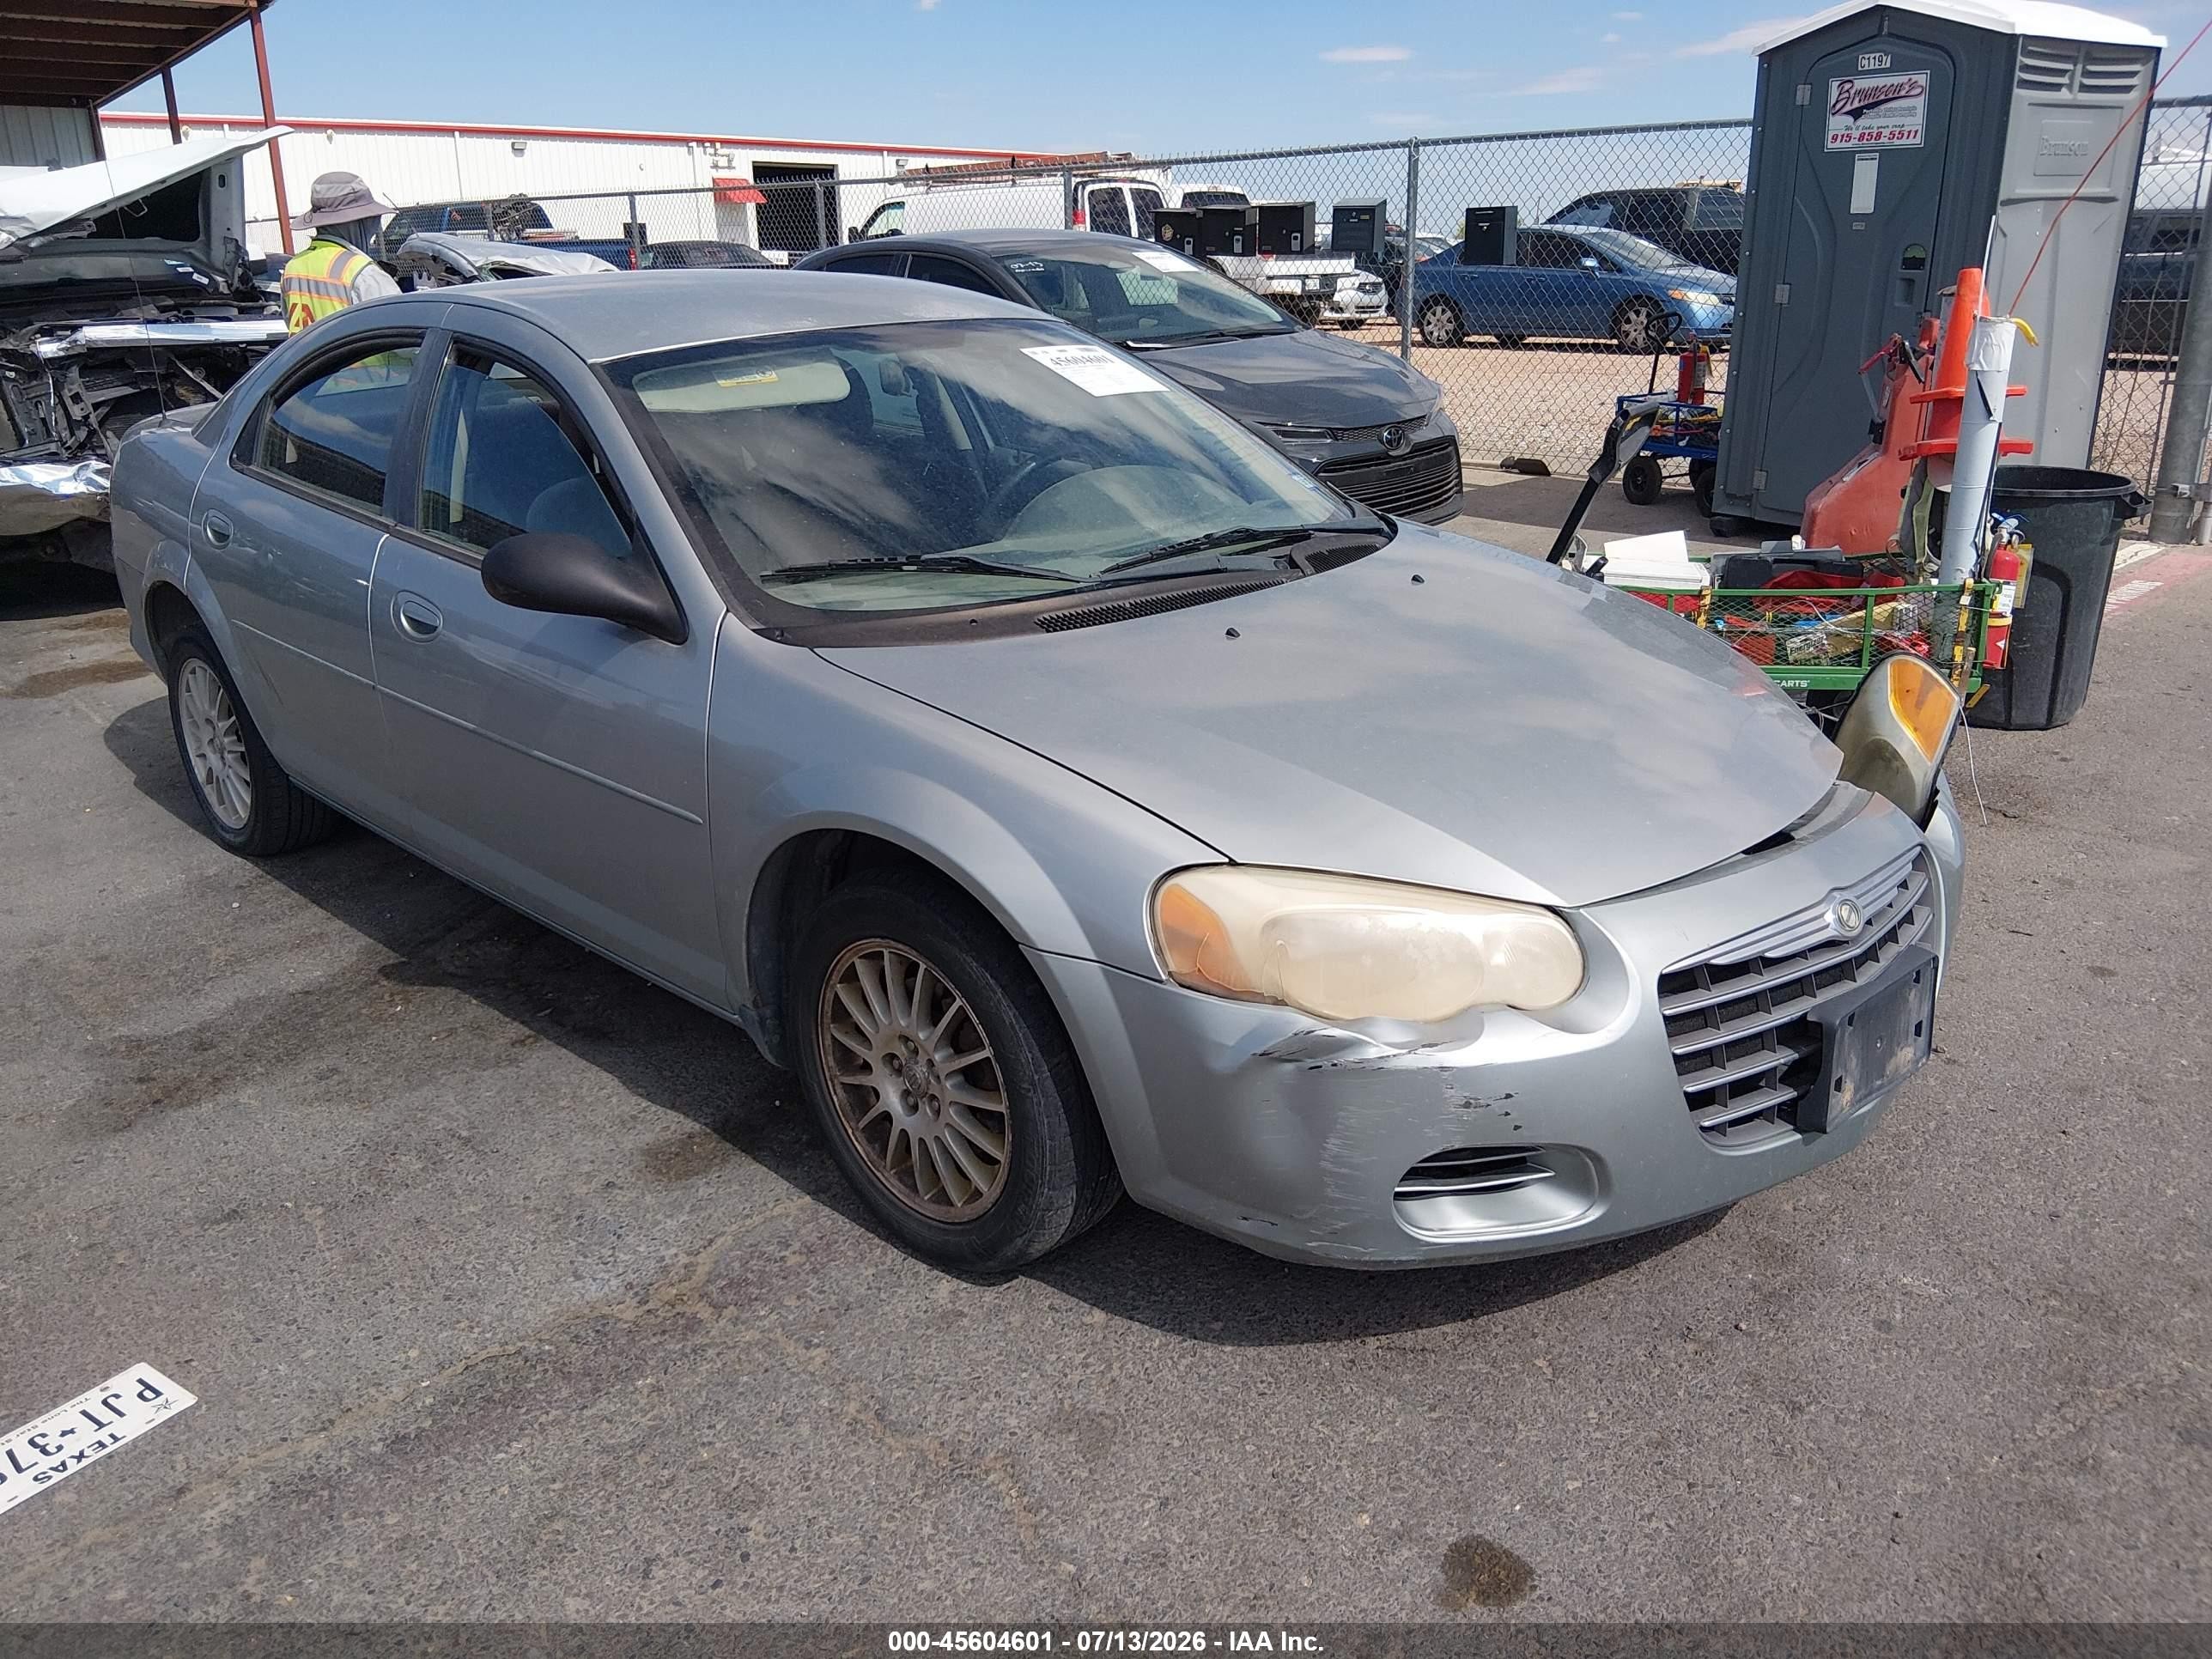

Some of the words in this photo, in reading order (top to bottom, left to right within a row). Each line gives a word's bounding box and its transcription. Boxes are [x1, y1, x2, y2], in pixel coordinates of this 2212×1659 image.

[1860, 54, 1891, 69] C1197
[1831, 78, 1924, 116] Brunson's
[1830, 128, 1919, 144] 915-858-5511
[32, 1432, 127, 1485] TEXAS
